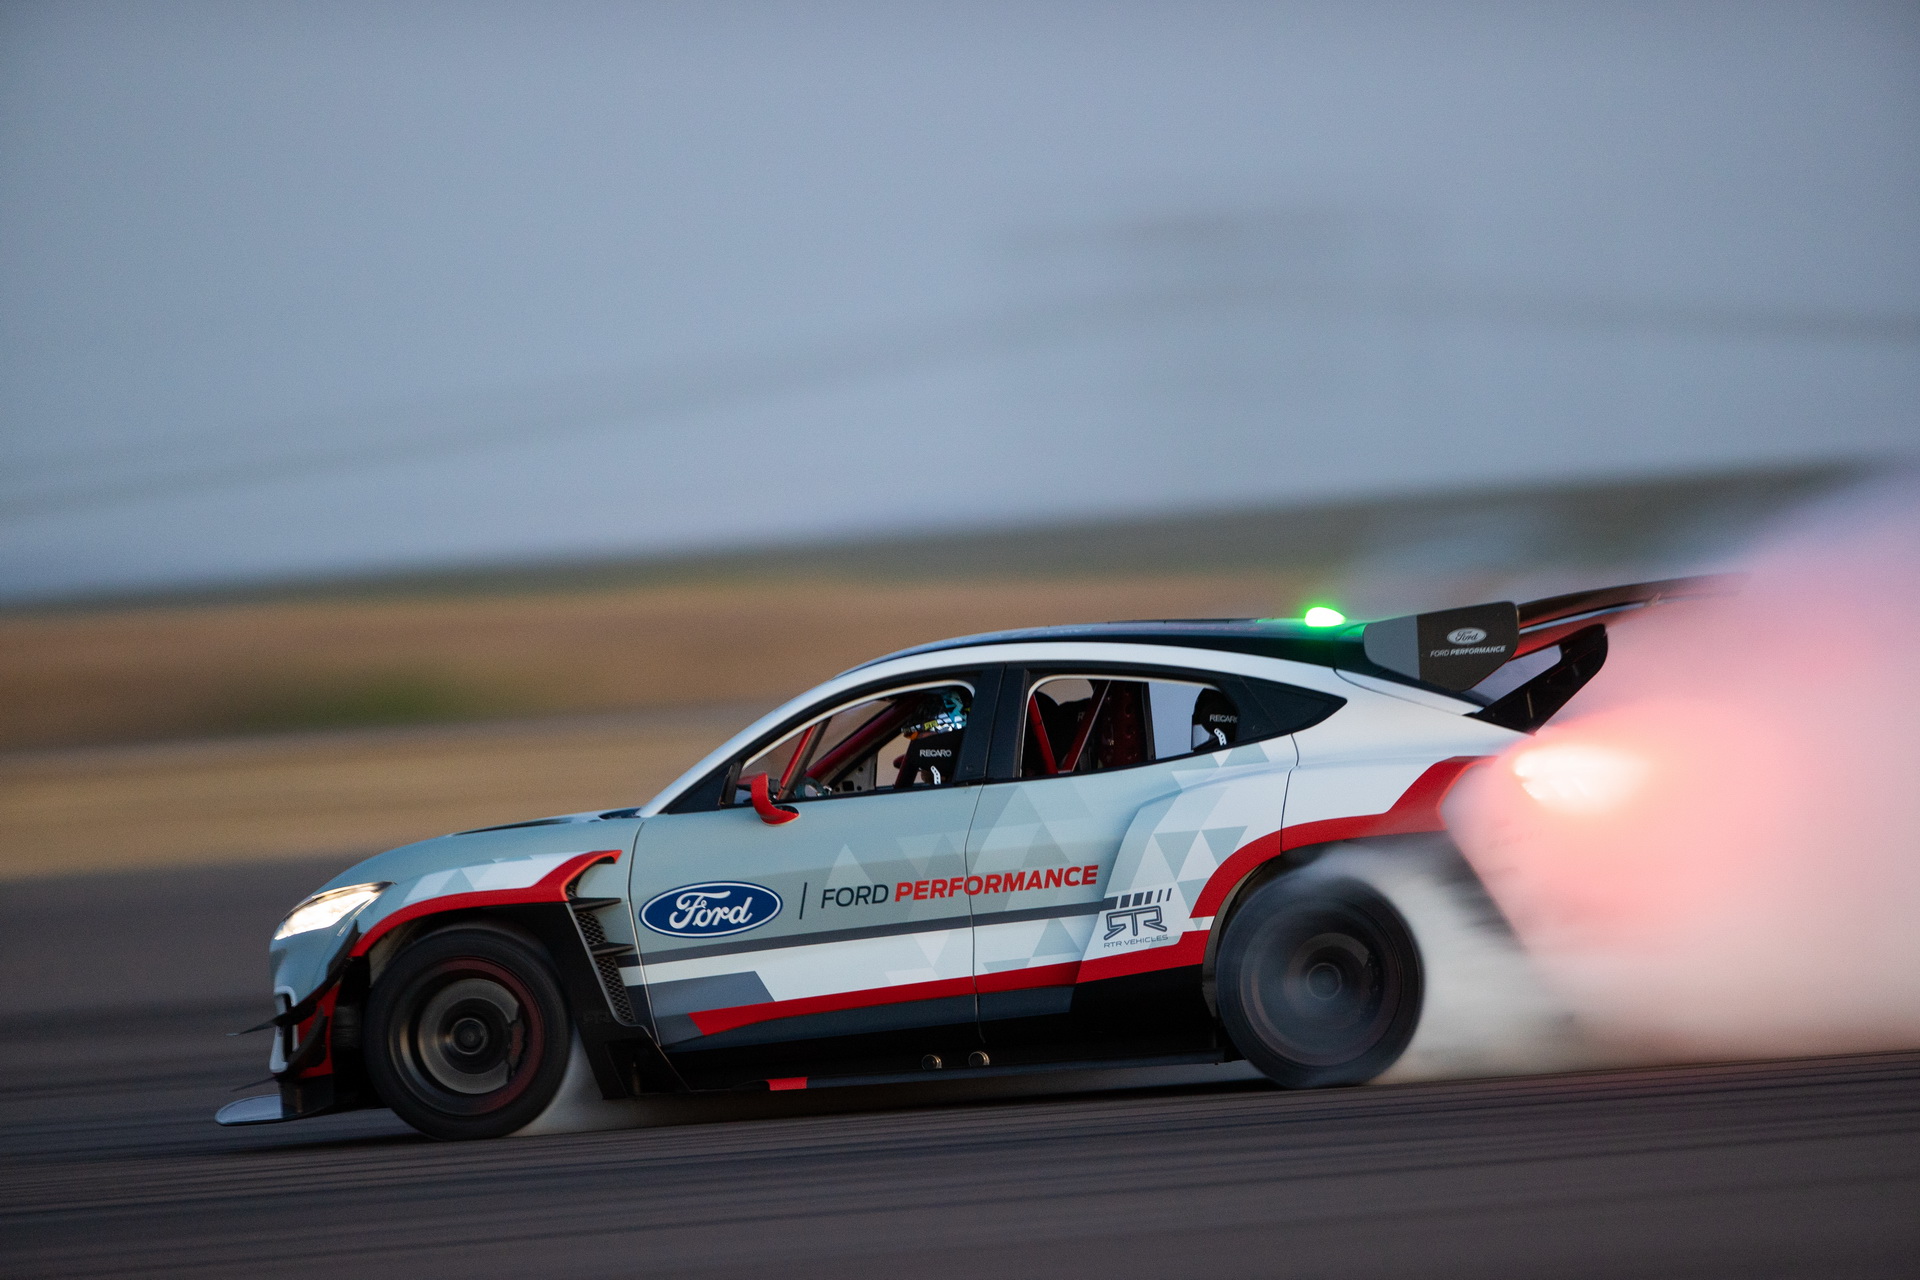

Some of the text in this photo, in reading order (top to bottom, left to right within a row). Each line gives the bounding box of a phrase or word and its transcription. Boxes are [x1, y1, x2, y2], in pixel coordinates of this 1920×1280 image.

[1455, 631, 1478, 641] Ford
[1430, 645, 1506, 658] FORD PERFORMANCE
[1209, 714, 1237, 723] RECAR
[920, 749, 952, 757] RECARO
[821, 865, 1099, 909] FORD PERFORMANCE
[669, 890, 753, 929] Ford
[1124, 934, 1168, 945] VEHICLES
